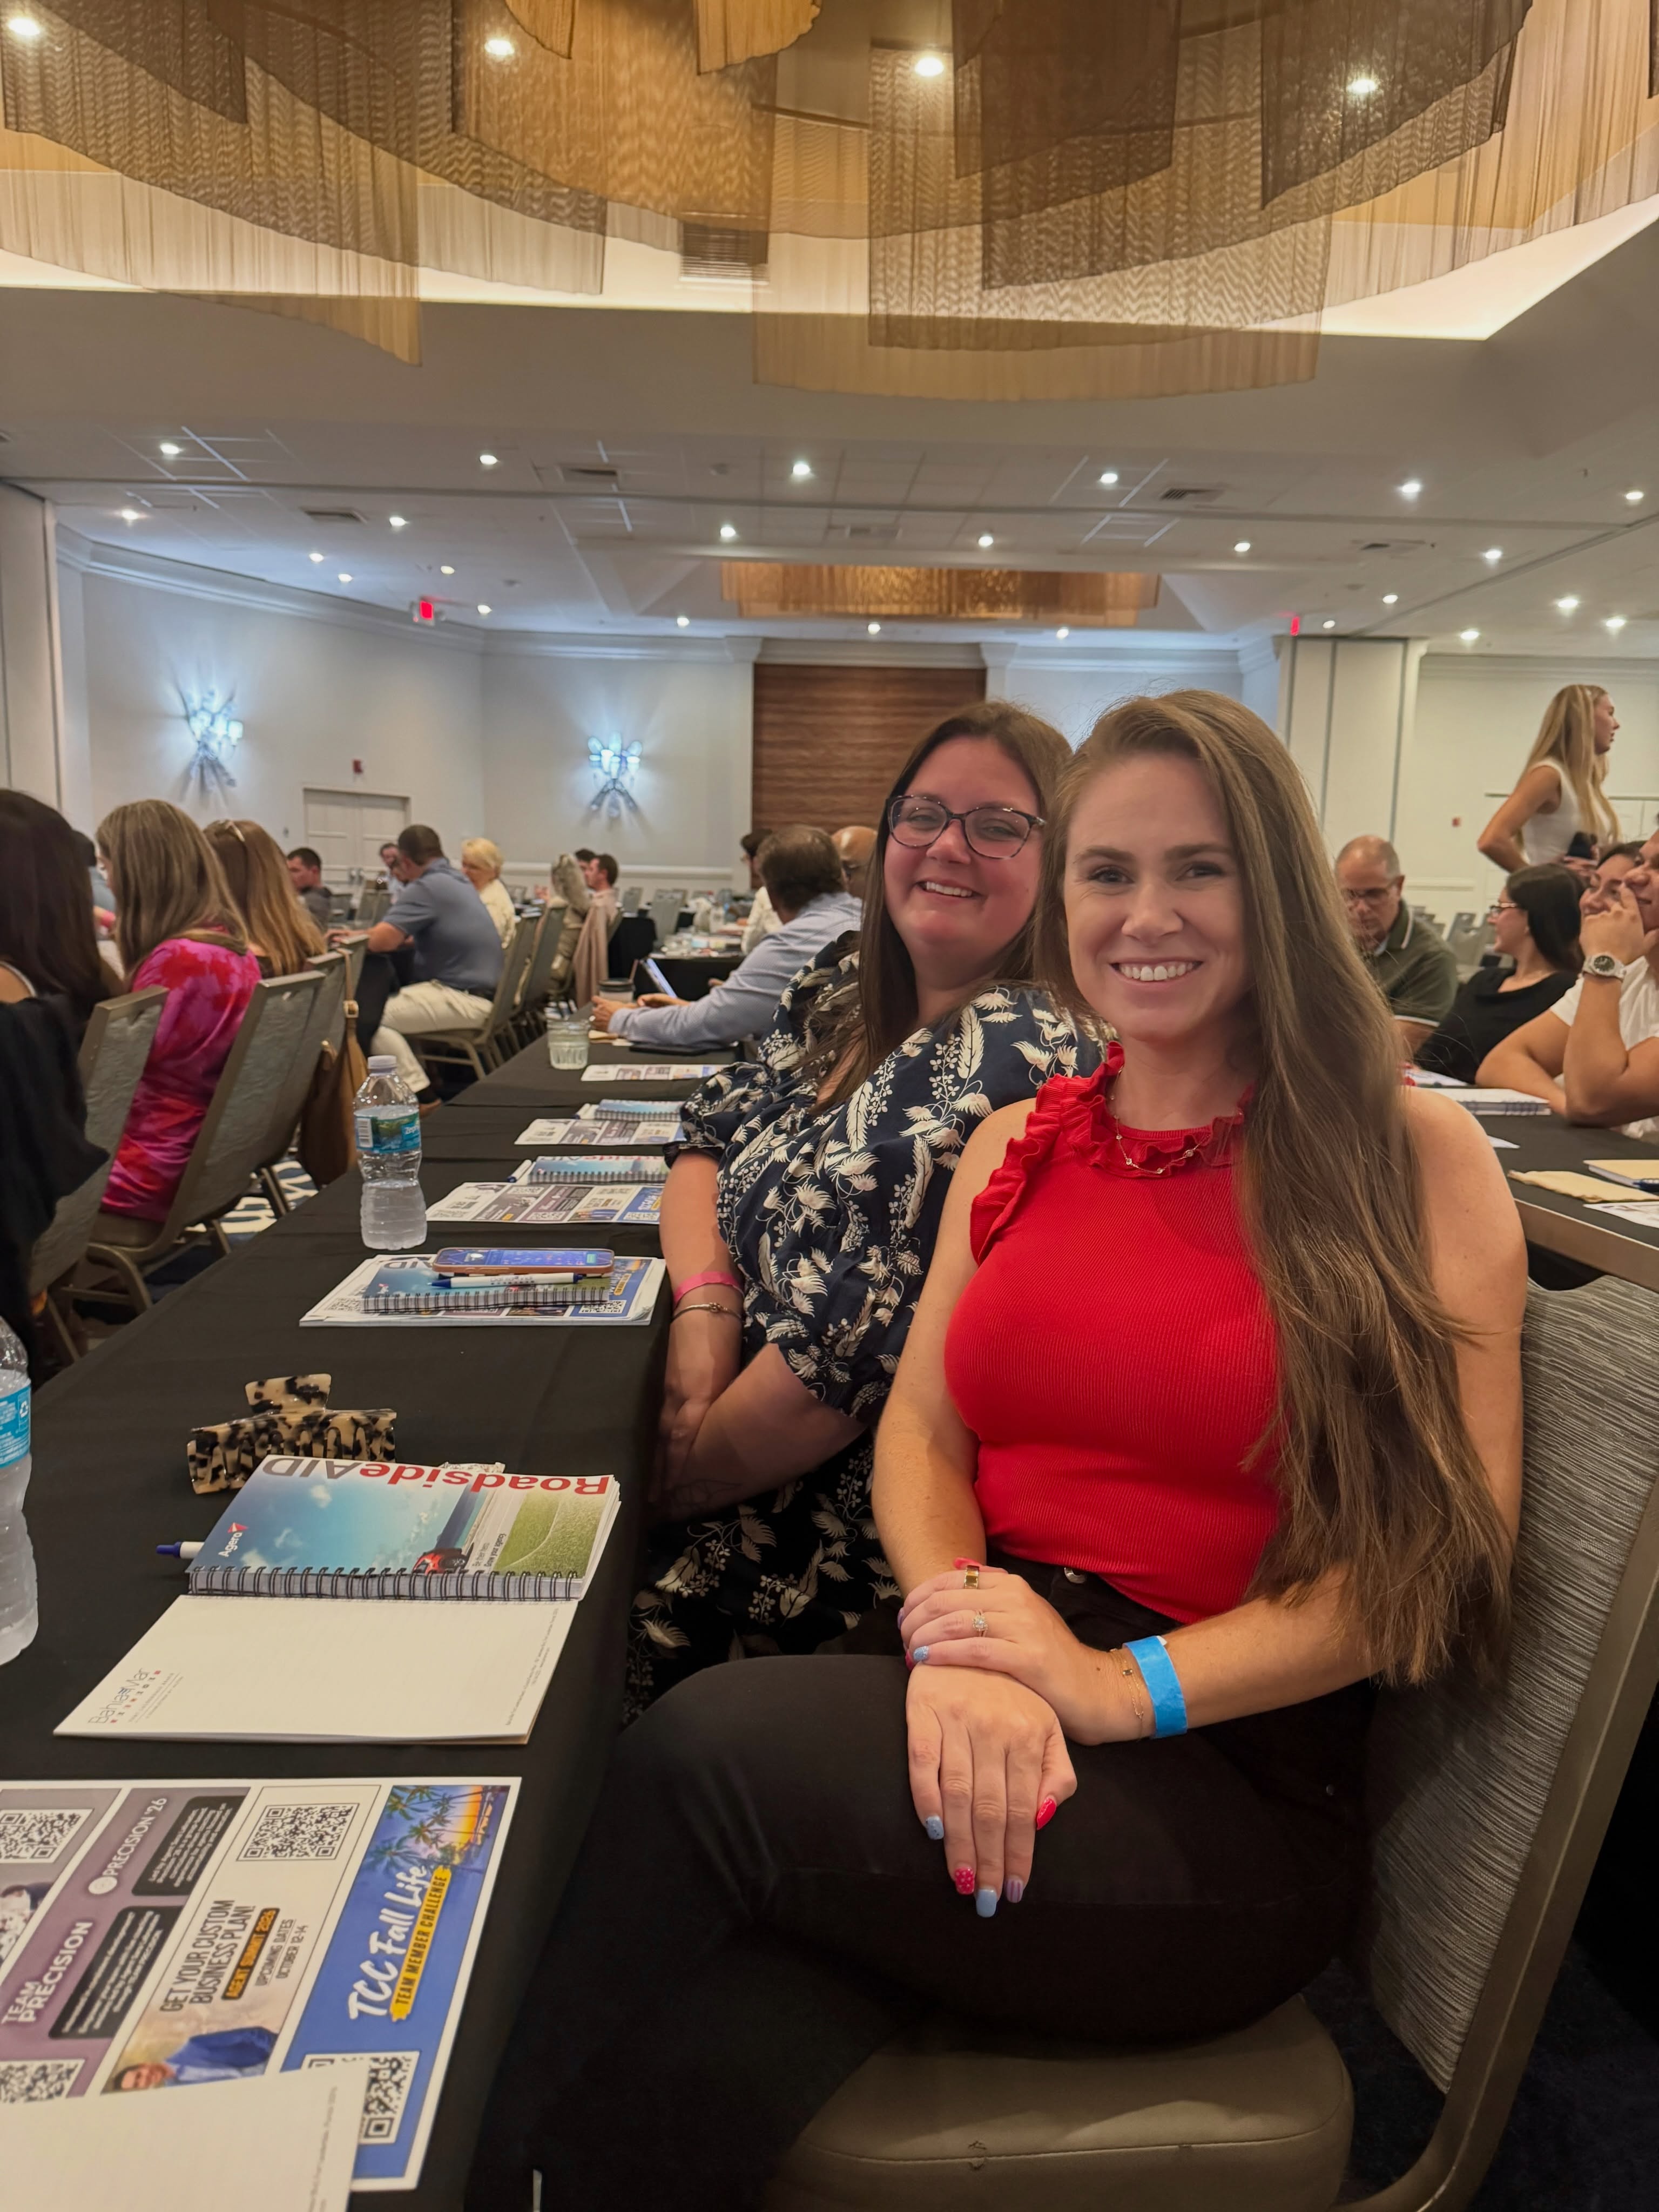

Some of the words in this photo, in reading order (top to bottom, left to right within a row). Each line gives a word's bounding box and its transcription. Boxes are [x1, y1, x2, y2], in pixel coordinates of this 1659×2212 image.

[262, 1458, 610, 1495] RoadsideAID
[218, 1532, 242, 1557] Agero
[105, 1816, 156, 1876] PRECISION
[384, 1865, 431, 1907] Life
[192, 1900, 235, 1949] CUSTOM
[369, 1907, 415, 1954] Fall
[395, 1977, 416, 2005] TEAM
[406, 1929, 430, 1974] MEMBER
[420, 1875, 447, 1927] CHALLENGE
[18, 1921, 93, 2024] PRECISION
[172, 1951, 210, 1985] YOUR
[188, 1943, 238, 2004] BUSINESS
[220, 1905, 256, 1940] PLAN!
[1, 1980, 40, 2025] TEAM
[159, 1987, 192, 2012] GET
[348, 1960, 399, 2020] TCC
